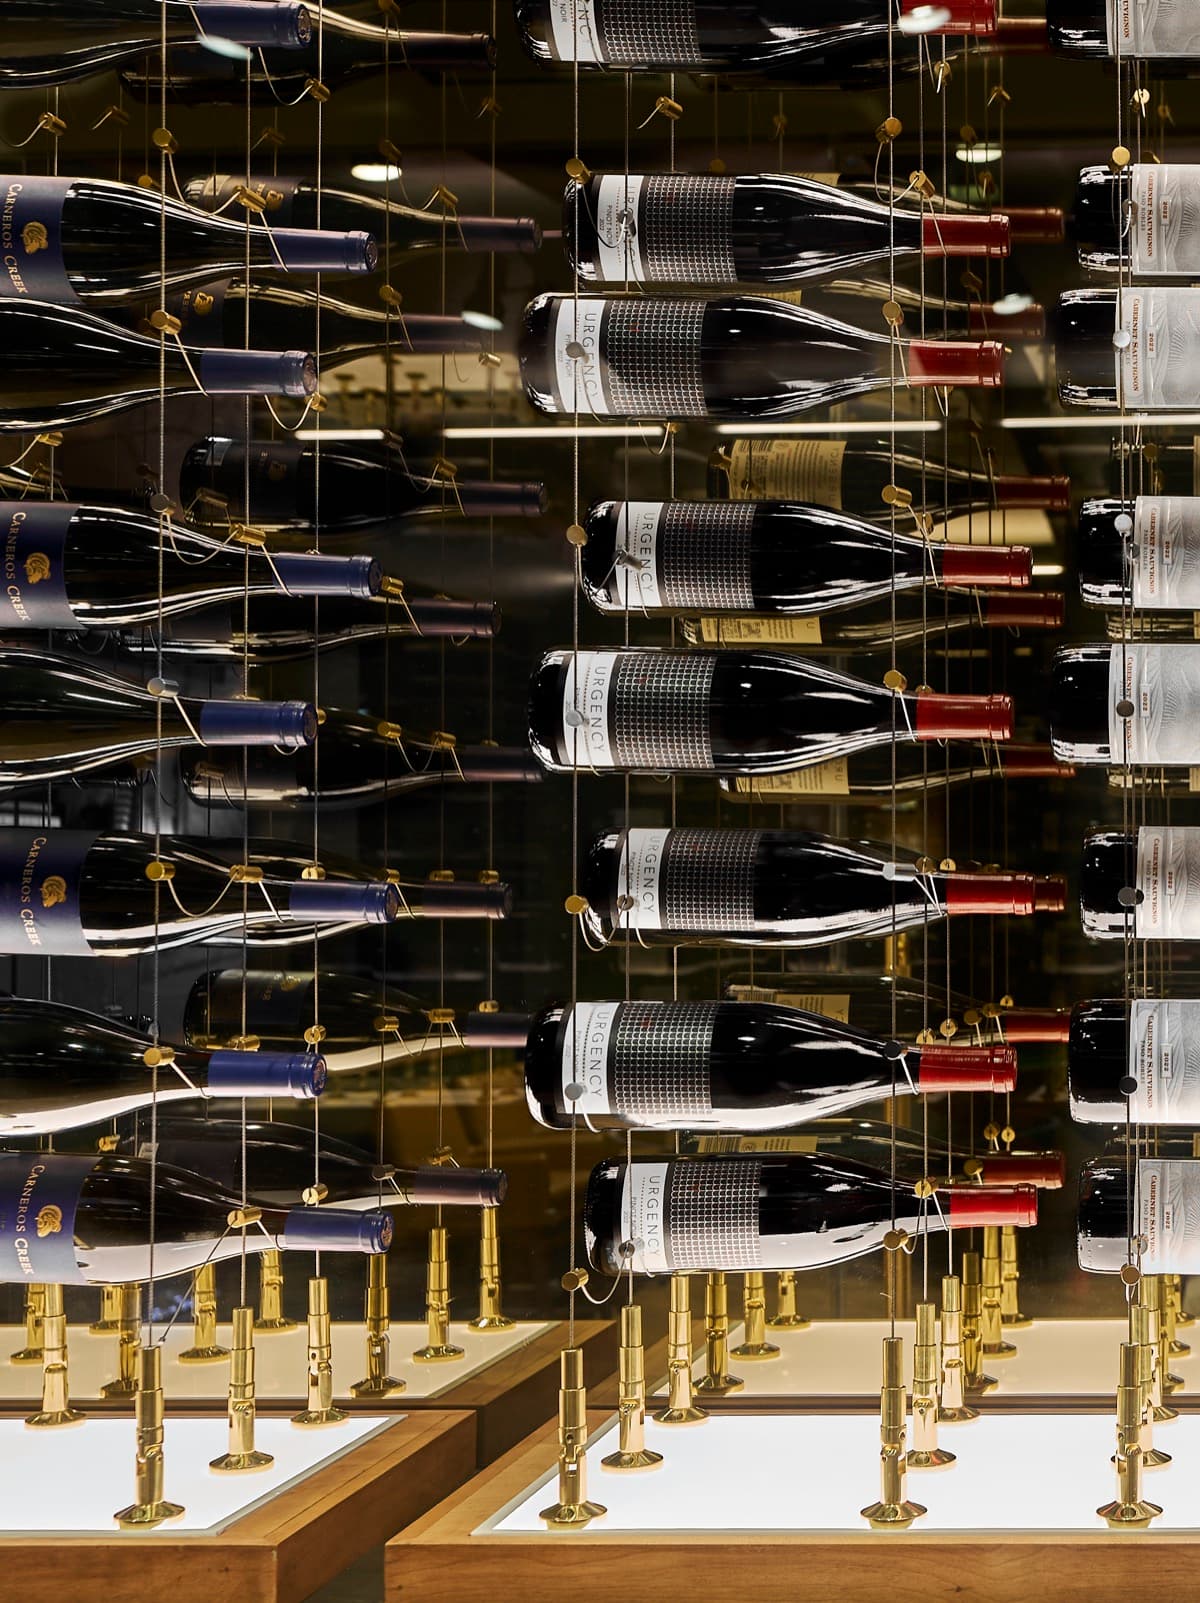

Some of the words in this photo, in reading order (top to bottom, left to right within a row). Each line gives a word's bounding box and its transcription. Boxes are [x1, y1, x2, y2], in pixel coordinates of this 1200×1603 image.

[2, 183, 23, 249] CARNEROS
[4, 255, 28, 294] CREEK
[1132, 298, 1140, 339] CABERNET
[582, 313, 598, 398] URGENCY
[1132, 341, 1140, 391] SAUVIGNON
[5, 511, 27, 580] CARNEROS
[640, 512, 656, 593] URGENCY
[7, 585, 32, 621] CREEK
[590, 666, 607, 752] URGENCY
[20, 836, 47, 903] CARNEROS
[643, 835, 661, 913] URGENCY
[1152, 838, 1160, 878] CABERNET
[19, 908, 42, 946] CREEK
[589, 1011, 609, 1097] URGENCY
[15, 1164, 46, 1233] CARNEROS
[647, 1175, 661, 1256] URGENCY
[14, 1237, 35, 1275] CREEK
